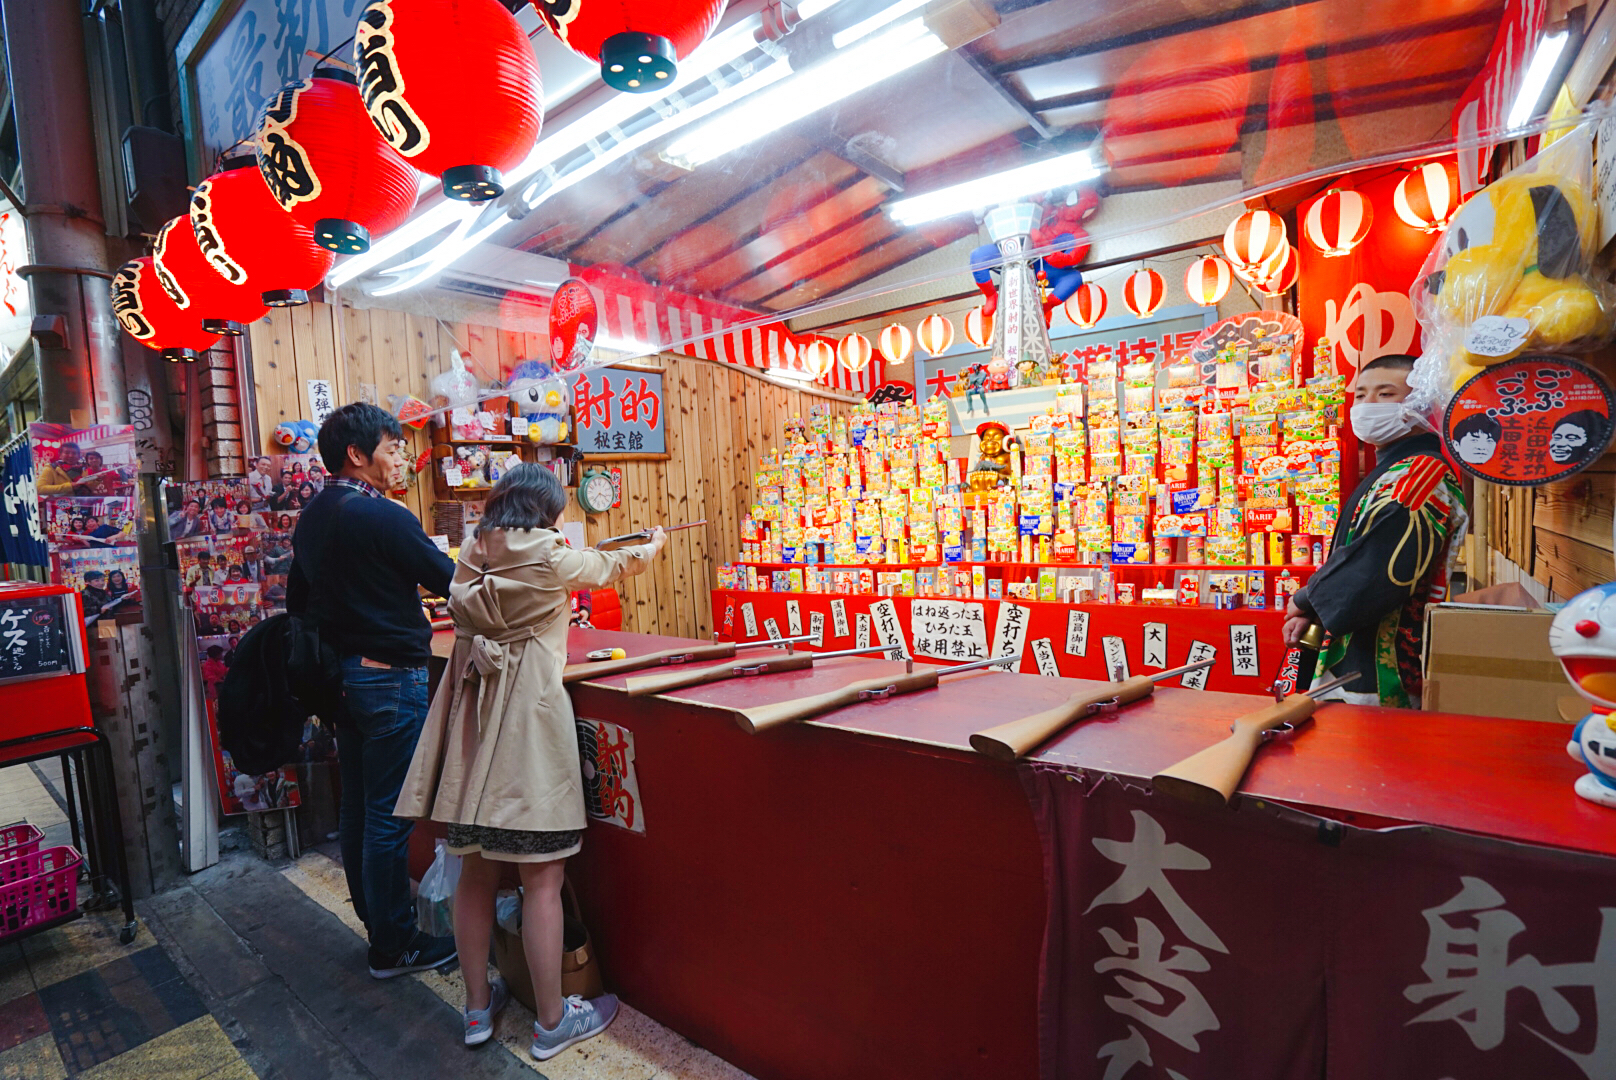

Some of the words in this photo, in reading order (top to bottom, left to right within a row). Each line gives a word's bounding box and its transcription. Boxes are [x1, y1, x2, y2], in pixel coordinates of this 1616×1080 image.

[572, 372, 660, 431] 射的
[594, 430, 643, 450] 秘宝館
[1248, 512, 1273, 520] MARIE
[790, 605, 800, 631] 大入
[913, 605, 982, 621] はね返った玉
[859, 615, 868, 648] 大当たり
[925, 622, 974, 636] ひろた玉
[1070, 612, 1085, 654] 満員御礼
[918, 638, 984, 658] 使用禁止
[1149, 628, 1162, 665] 大入
[1234, 631, 1255, 669] 新世界
[595, 722, 635, 828] 射的
